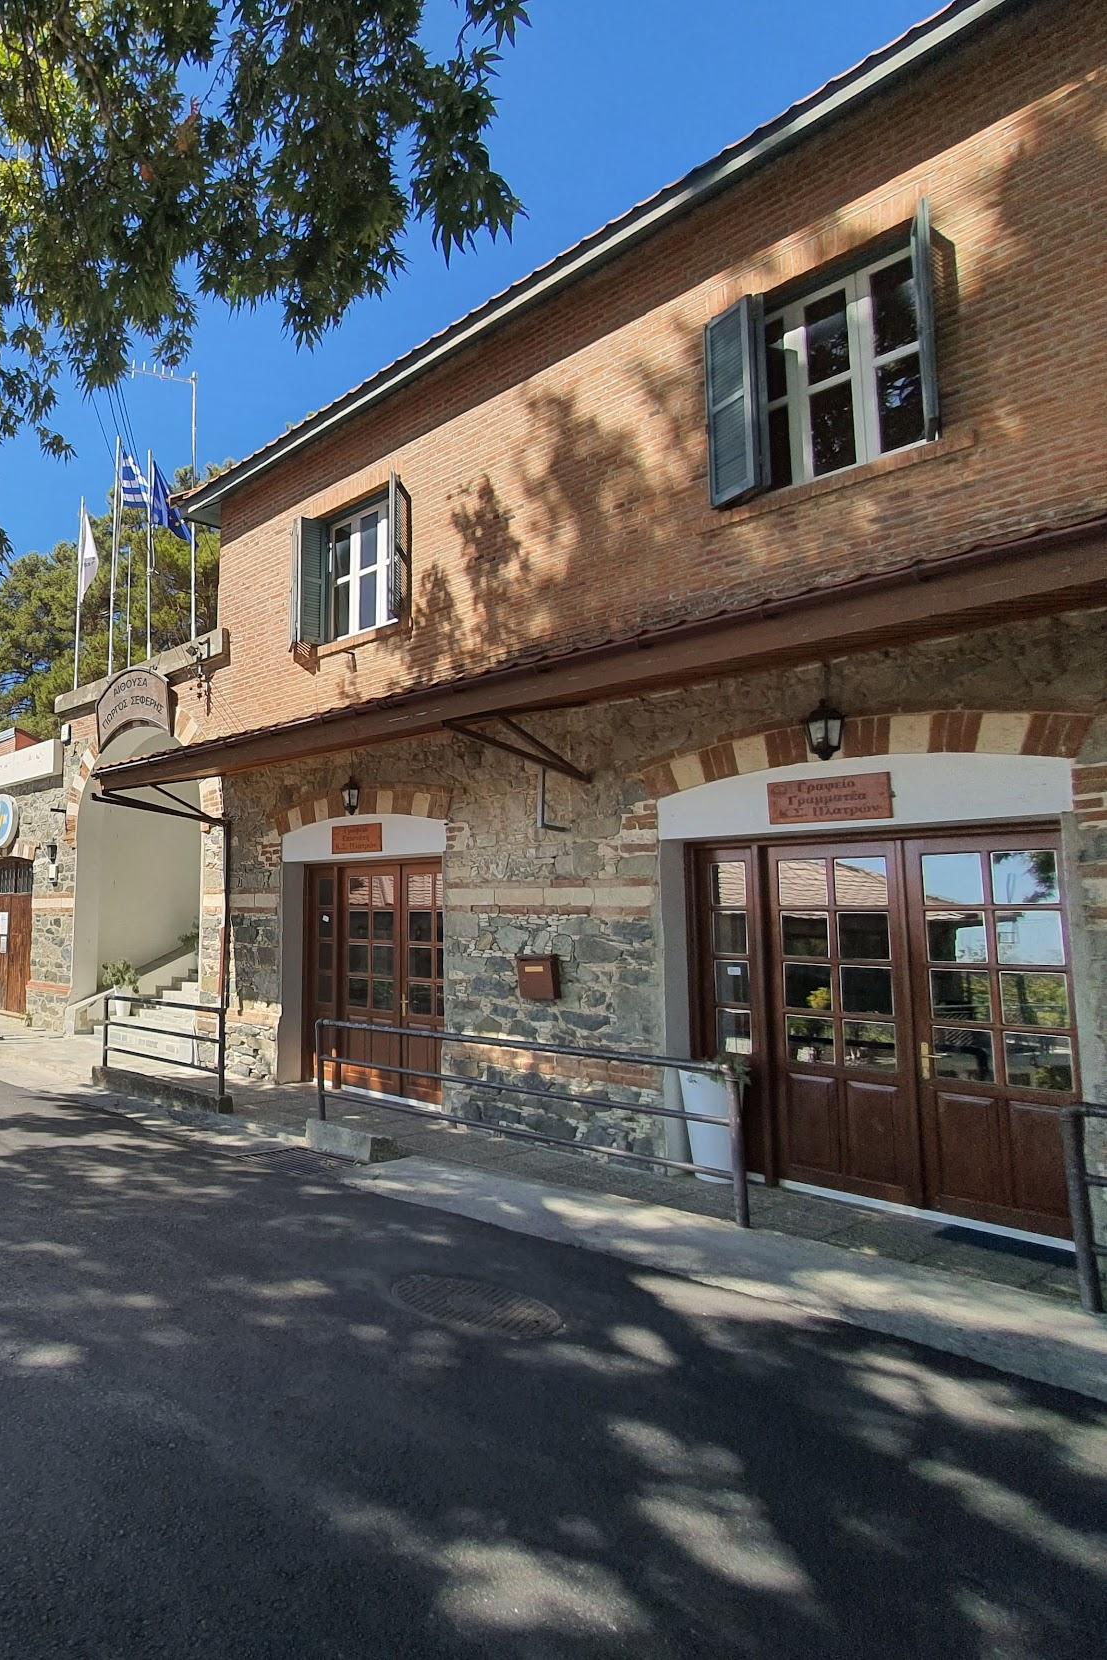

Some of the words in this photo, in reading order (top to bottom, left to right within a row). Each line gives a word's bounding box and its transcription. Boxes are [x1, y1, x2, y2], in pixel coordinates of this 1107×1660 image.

[113, 677, 148, 697] ΑΙΘΟΥΣΑ
[102, 698, 128, 729] ΓΙΩΡΓΟΣ
[130, 695, 164, 715] ΣΕΦΕΡΗΣ
[797, 779, 856, 794] Γραφείο
